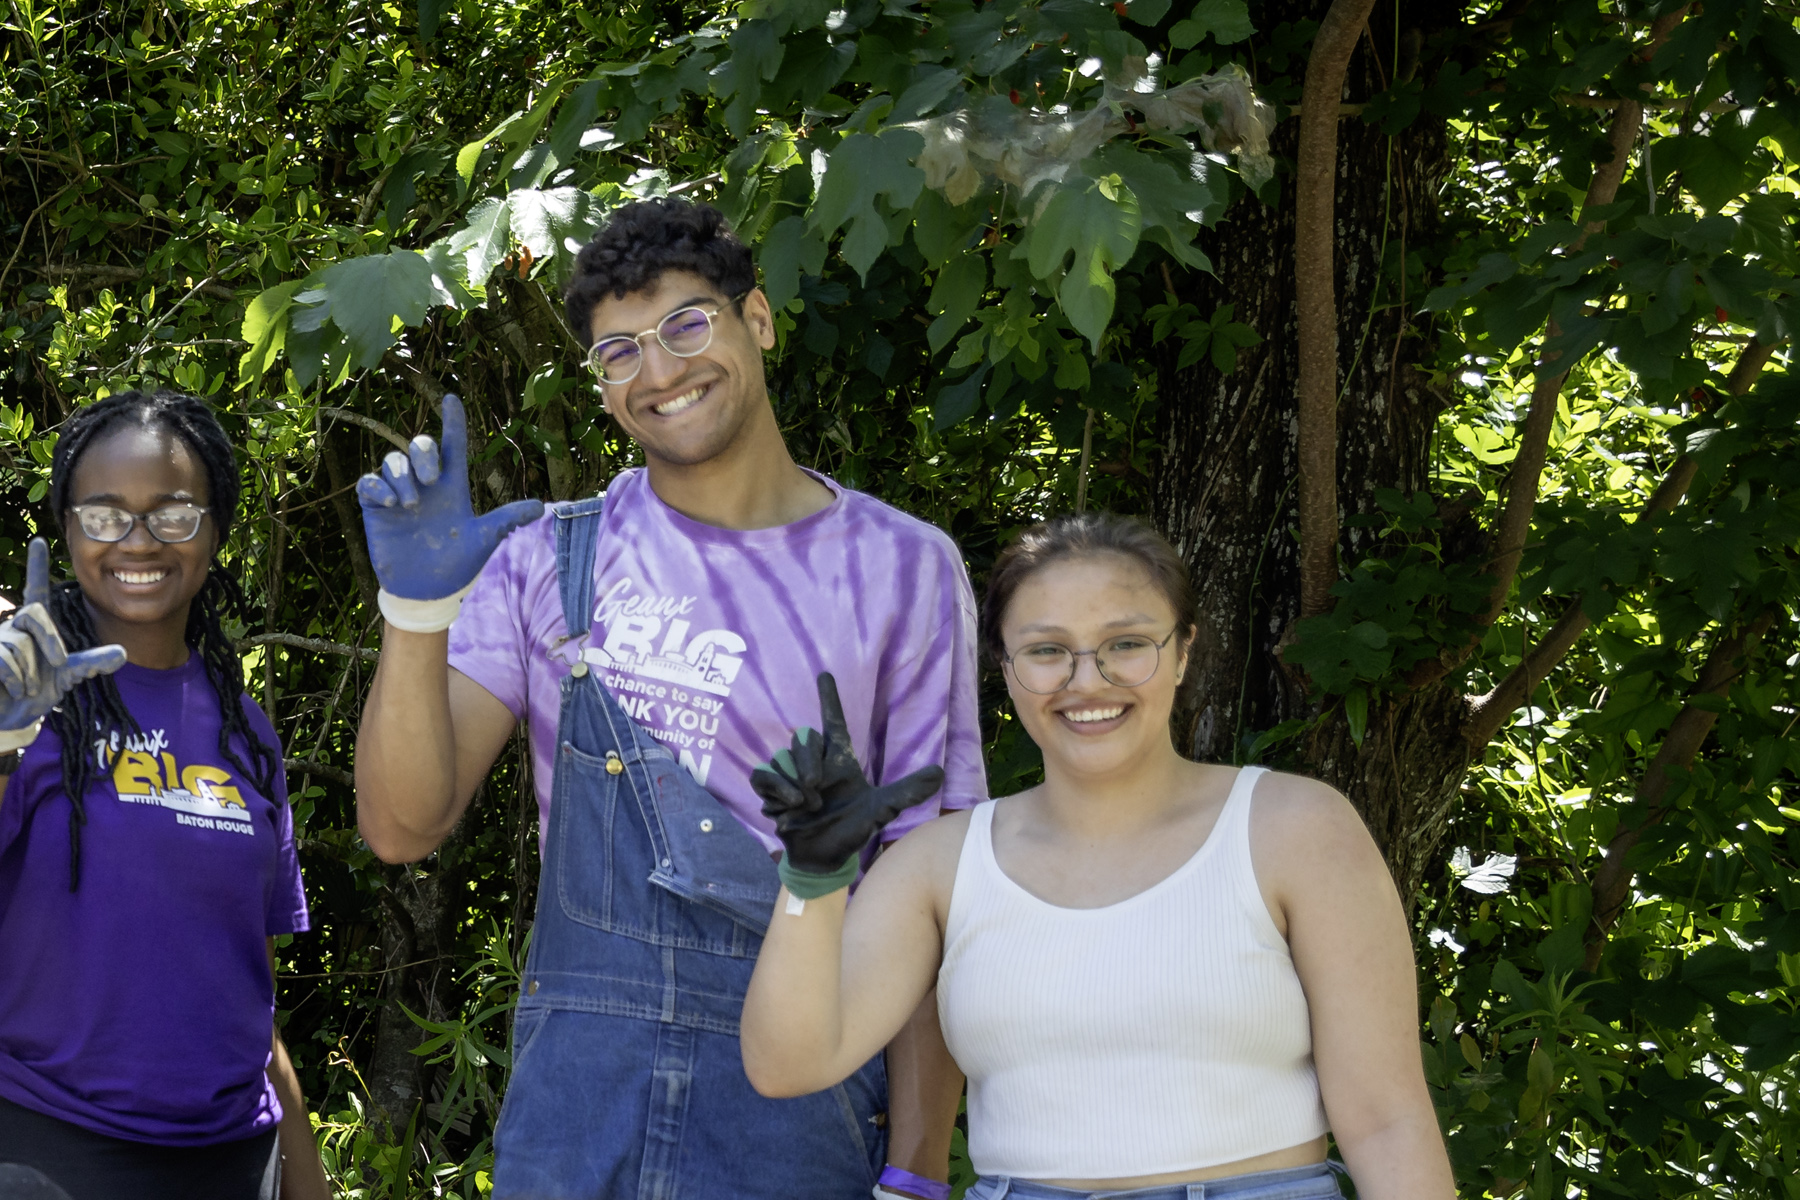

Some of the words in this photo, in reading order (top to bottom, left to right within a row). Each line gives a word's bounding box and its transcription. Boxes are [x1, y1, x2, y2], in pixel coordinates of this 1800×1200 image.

[594, 577, 697, 626] Geaux
[603, 615, 747, 684] BIG
[605, 673, 667, 699] chance
[671, 686, 688, 704] to
[692, 694, 724, 716] say
[663, 703, 720, 736] YOU
[697, 738, 716, 751] of
[105, 744, 246, 810] BIG
[176, 812, 215, 830] BATON
[215, 819, 255, 836] ROUGE
